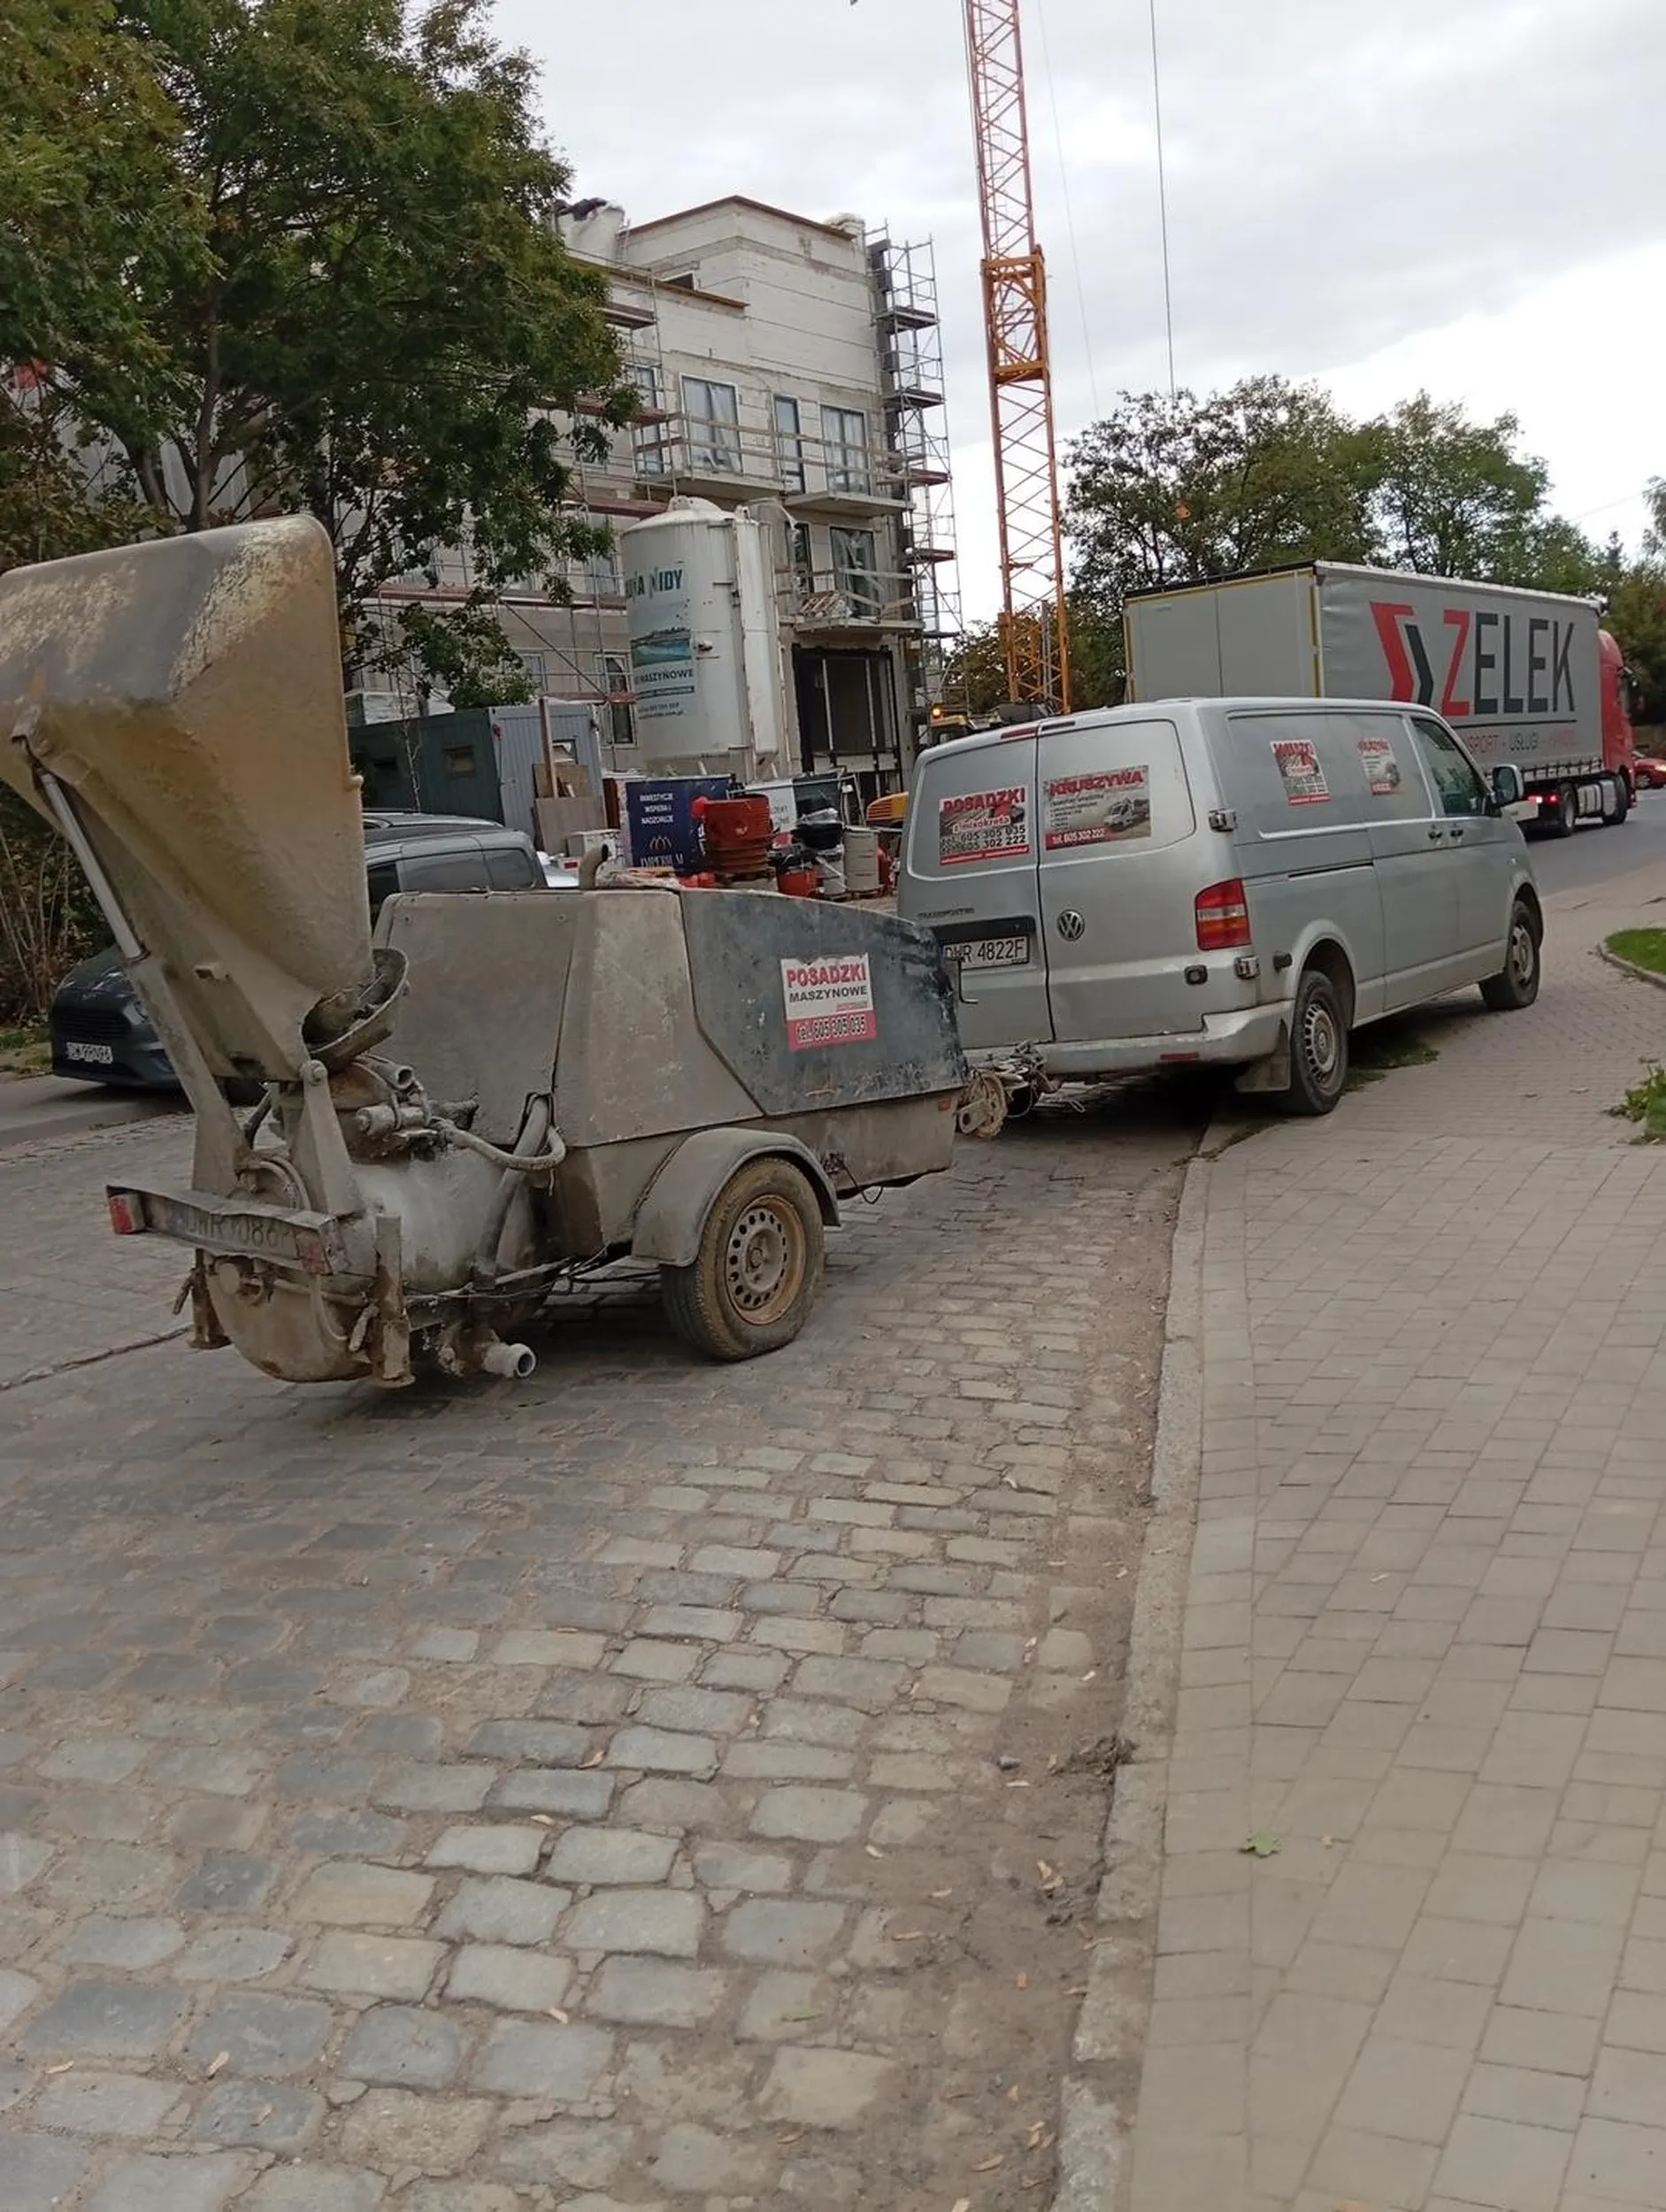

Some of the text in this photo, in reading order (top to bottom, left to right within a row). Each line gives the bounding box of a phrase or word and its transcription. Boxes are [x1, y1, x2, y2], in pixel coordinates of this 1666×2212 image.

[1441, 610, 1576, 716] ZELEK
[943, 787, 1025, 812] POSADZKI
[1005, 834, 1026, 846] 222
[977, 939, 1025, 961] 4822F
[787, 963, 866, 988] POSADZKI
[789, 985, 867, 1003] MASZYNOWE
